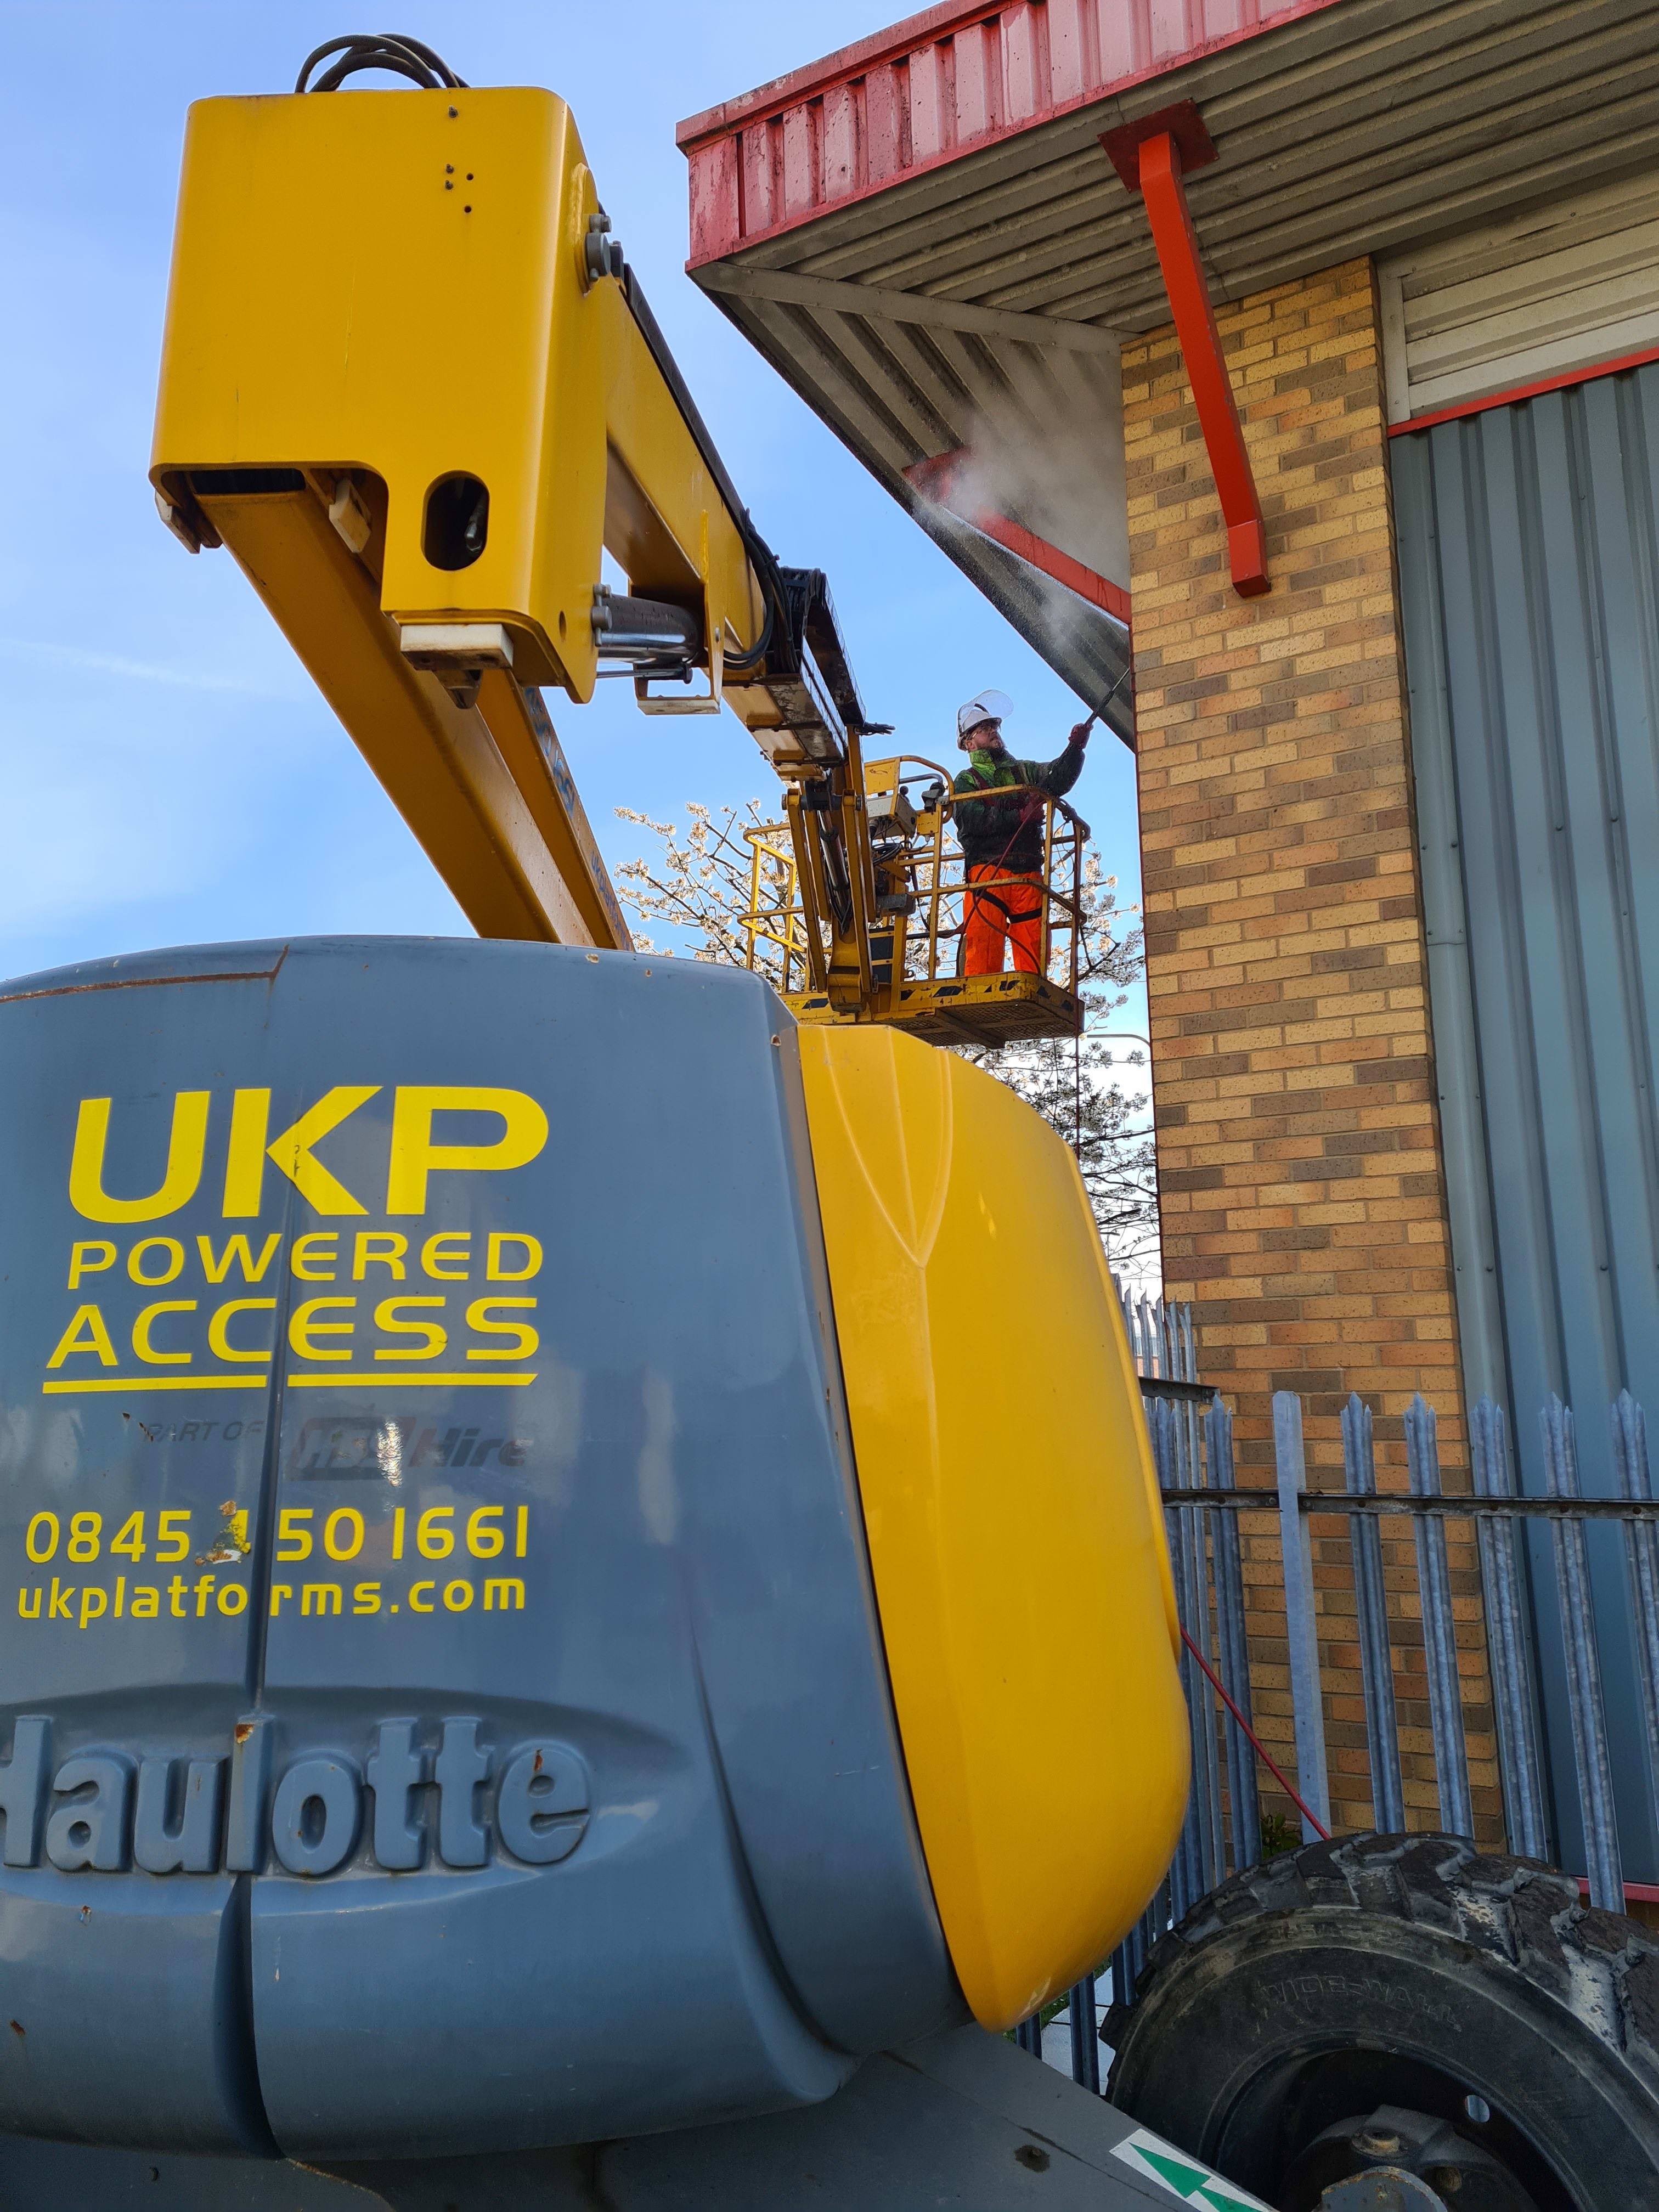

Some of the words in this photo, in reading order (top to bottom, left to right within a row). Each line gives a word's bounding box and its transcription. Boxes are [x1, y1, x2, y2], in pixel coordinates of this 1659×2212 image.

[69, 1086, 549, 1224] UKP
[69, 1232, 543, 1290] POWERED
[47, 1297, 539, 1369] ACCESS
[26, 1510, 191, 1564] 0845
[392, 1505, 528, 1560] 1661
[18, 1575, 525, 1629] ukplatforms.com
